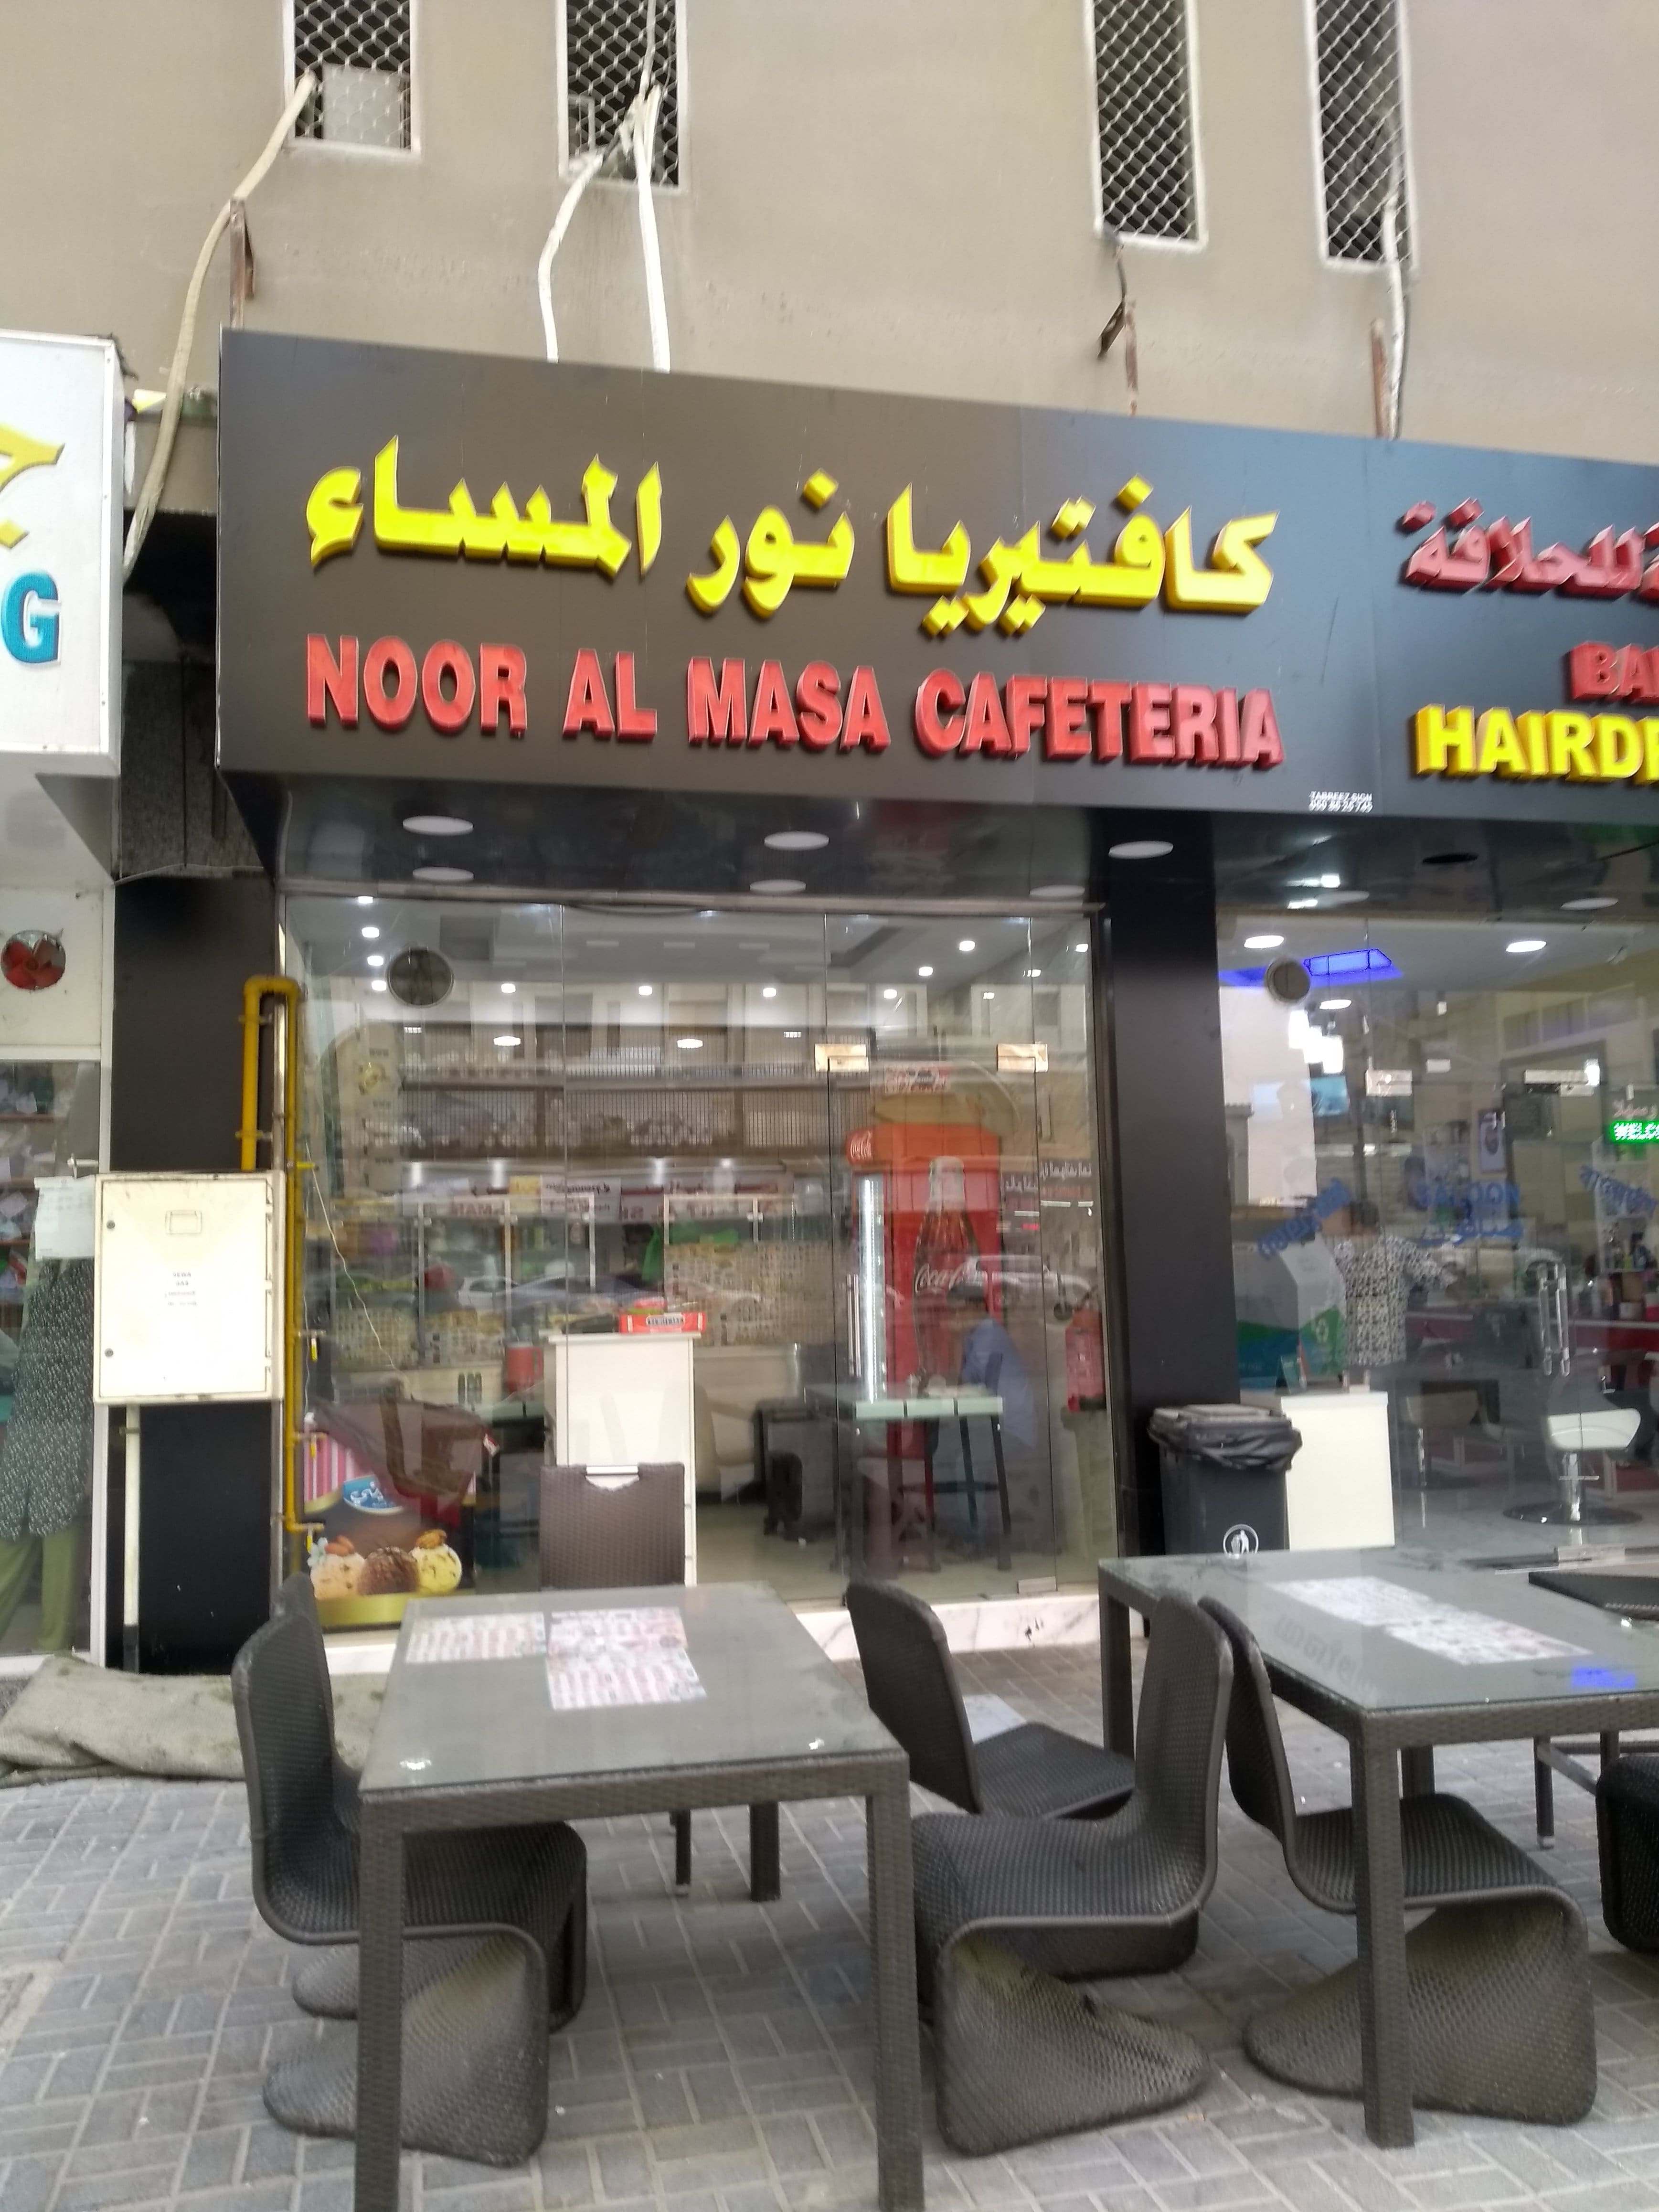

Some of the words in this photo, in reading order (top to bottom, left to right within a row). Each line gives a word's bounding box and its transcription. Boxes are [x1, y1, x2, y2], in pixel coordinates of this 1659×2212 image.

[307, 435, 662, 575] المساء
[687, 468, 855, 617] نور
[887, 474, 1279, 636] كافتيريا
[1402, 498, 1644, 597] للحلاقة
[307, 634, 528, 737] NOOR
[563, 649, 658, 741] AL
[687, 657, 891, 753] MASA
[915, 668, 1286, 770] CAFETERIA
